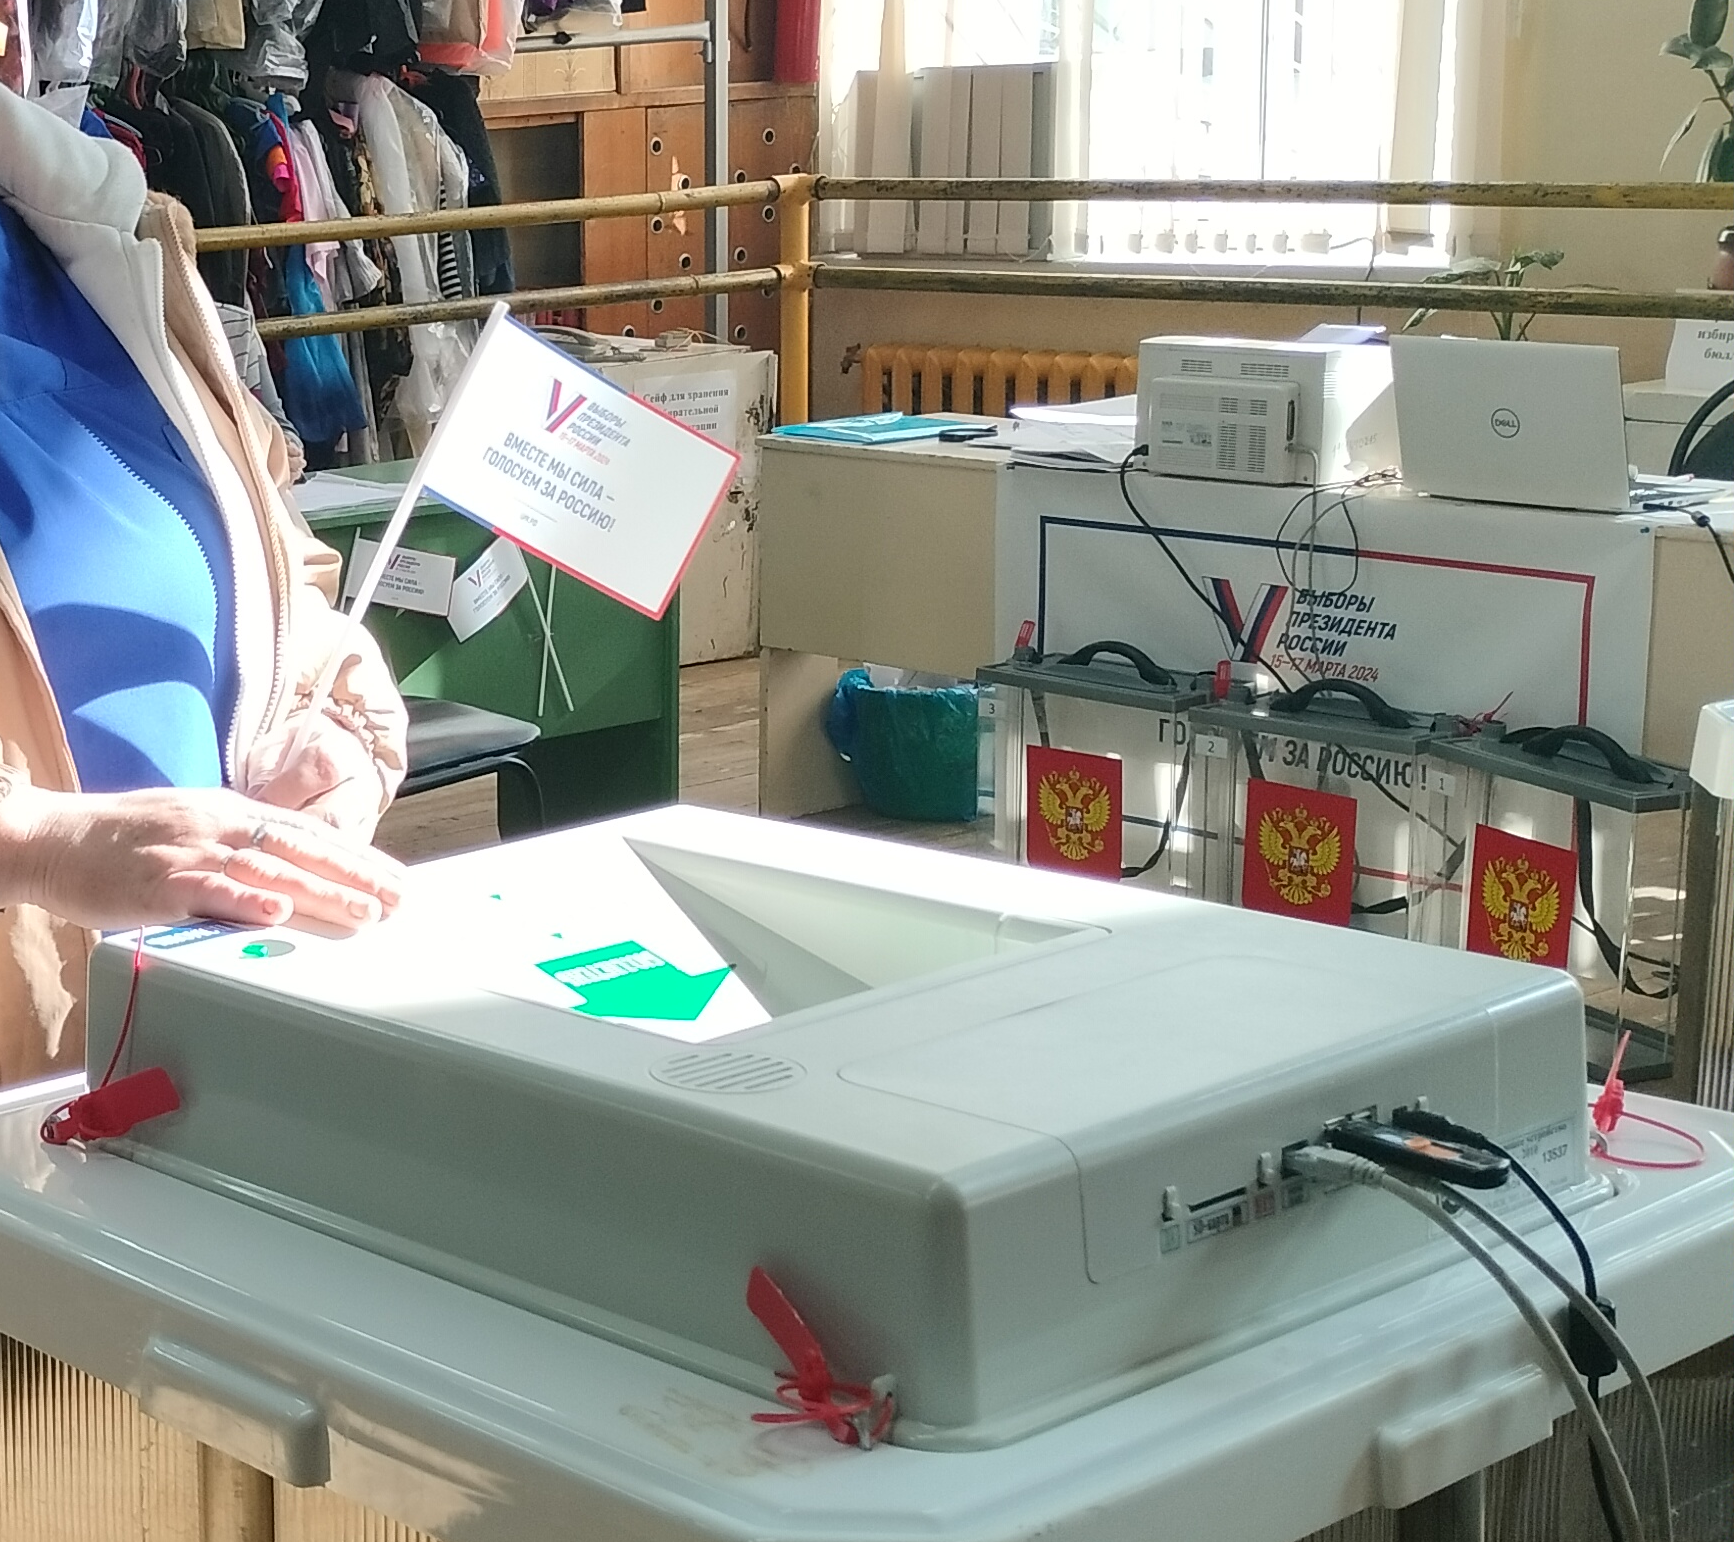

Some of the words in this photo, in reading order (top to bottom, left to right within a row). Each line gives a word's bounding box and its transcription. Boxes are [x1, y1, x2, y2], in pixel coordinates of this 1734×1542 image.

[1704, 347, 1734, 361] бюл
[643, 392, 667, 405] Сейф
[687, 389, 729, 402] хранения
[587, 402, 627, 428] ВЫБОРЫ
[1495, 419, 1517, 428] DELL
[567, 423, 602, 446] РОССИИ
[577, 412, 631, 447] ПРЕЗИДЕНТА
[503, 432, 549, 468] ВМЕСТЕ
[547, 457, 572, 482] МЫ
[570, 471, 604, 501] СИЛА
[482, 446, 542, 491] ГОЛОСУЕМ
[540, 481, 557, 501] ЗА
[556, 490, 617, 533] РОССИЮ!
[1296, 588, 1376, 613] ВЫБОРЫ
[1290, 611, 1398, 640] ПРЕЗИДЕНТА
[1276, 633, 1348, 657] РОССИИ
[1304, 660, 1346, 678] МАРТА
[1348, 665, 1379, 683] 2024
[988, 703, 995, 715] 3
[1208, 740, 1215, 754] 2
[1282, 739, 1309, 770] ЗА
[1439, 777, 1445, 790] 1
